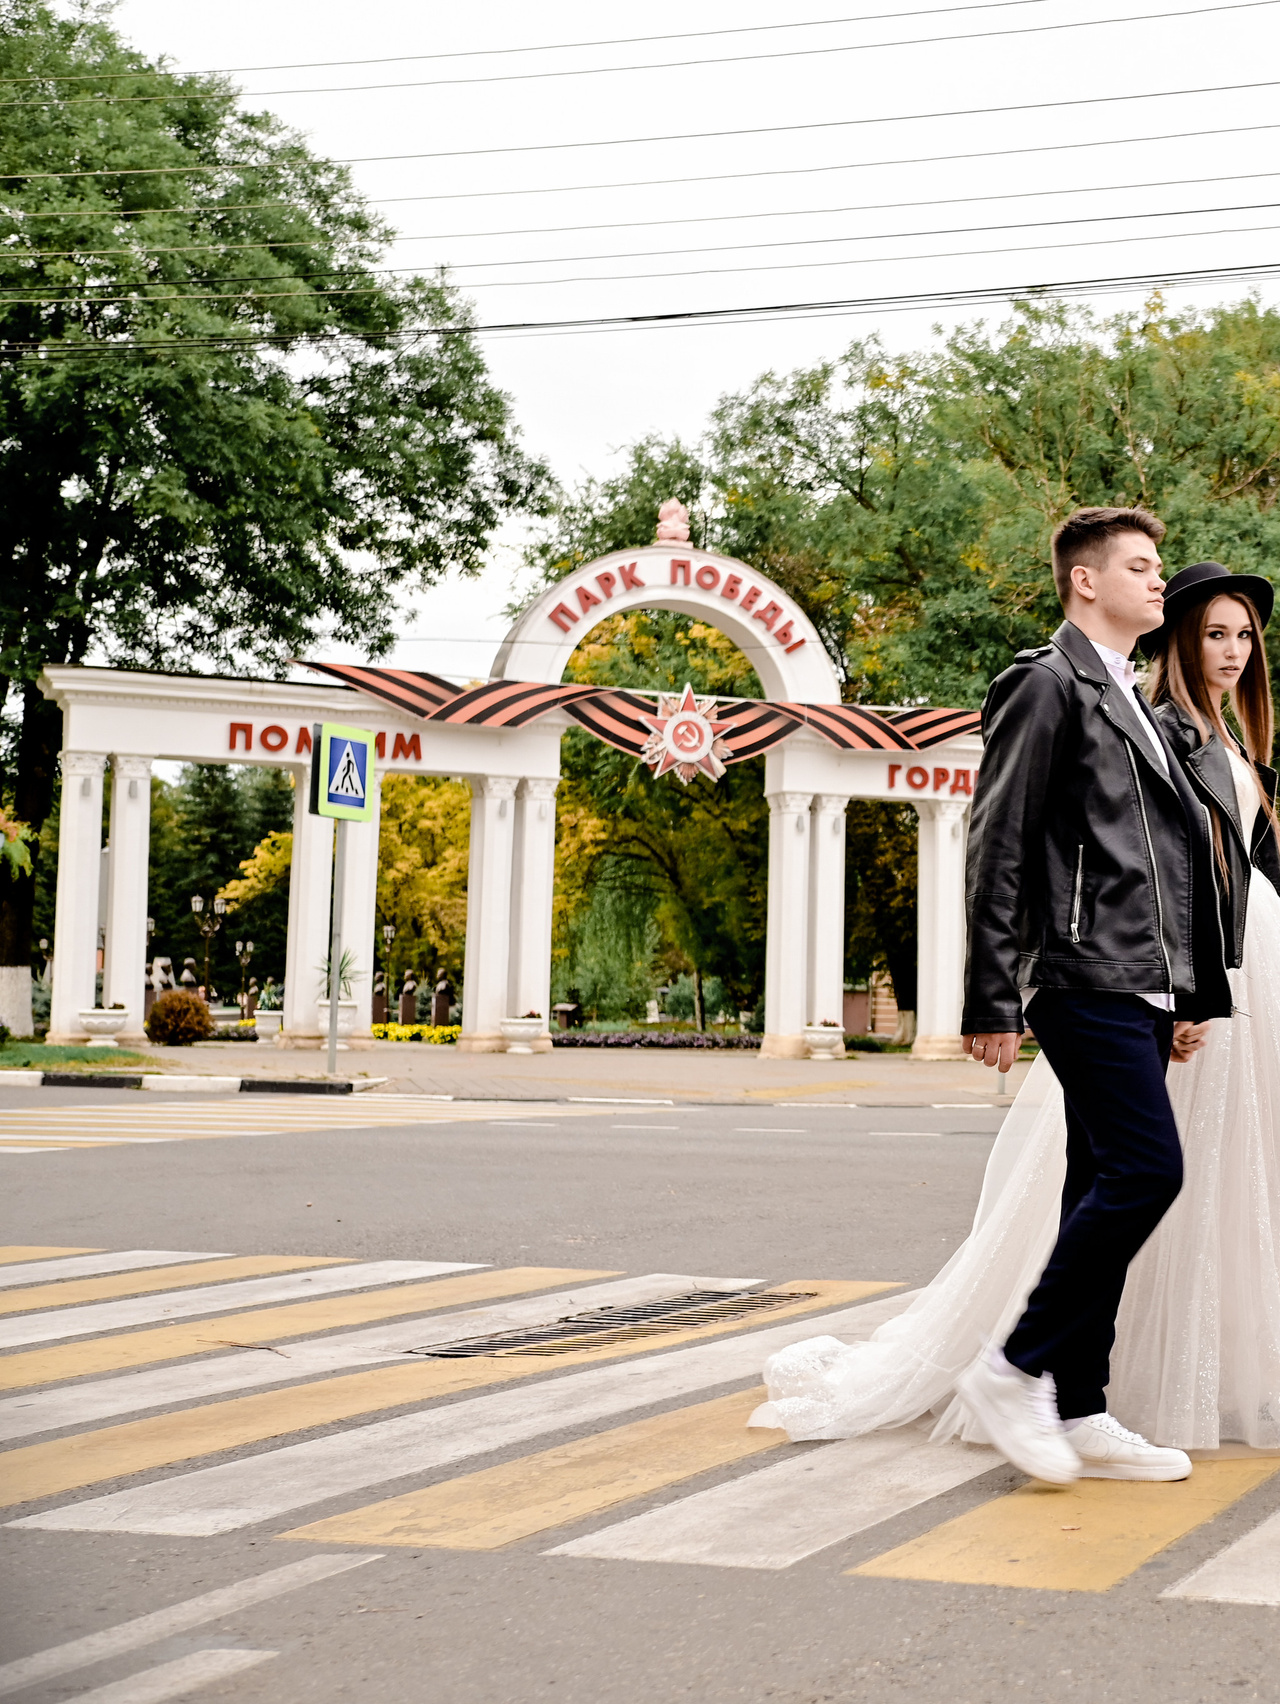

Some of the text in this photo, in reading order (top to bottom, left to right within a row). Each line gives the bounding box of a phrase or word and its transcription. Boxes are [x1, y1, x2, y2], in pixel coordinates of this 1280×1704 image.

[547, 558, 806, 655] ПАРК ПОБЕДЫ
[229, 722, 422, 761] ПОМИМ
[888, 764, 979, 796] ГОРД
